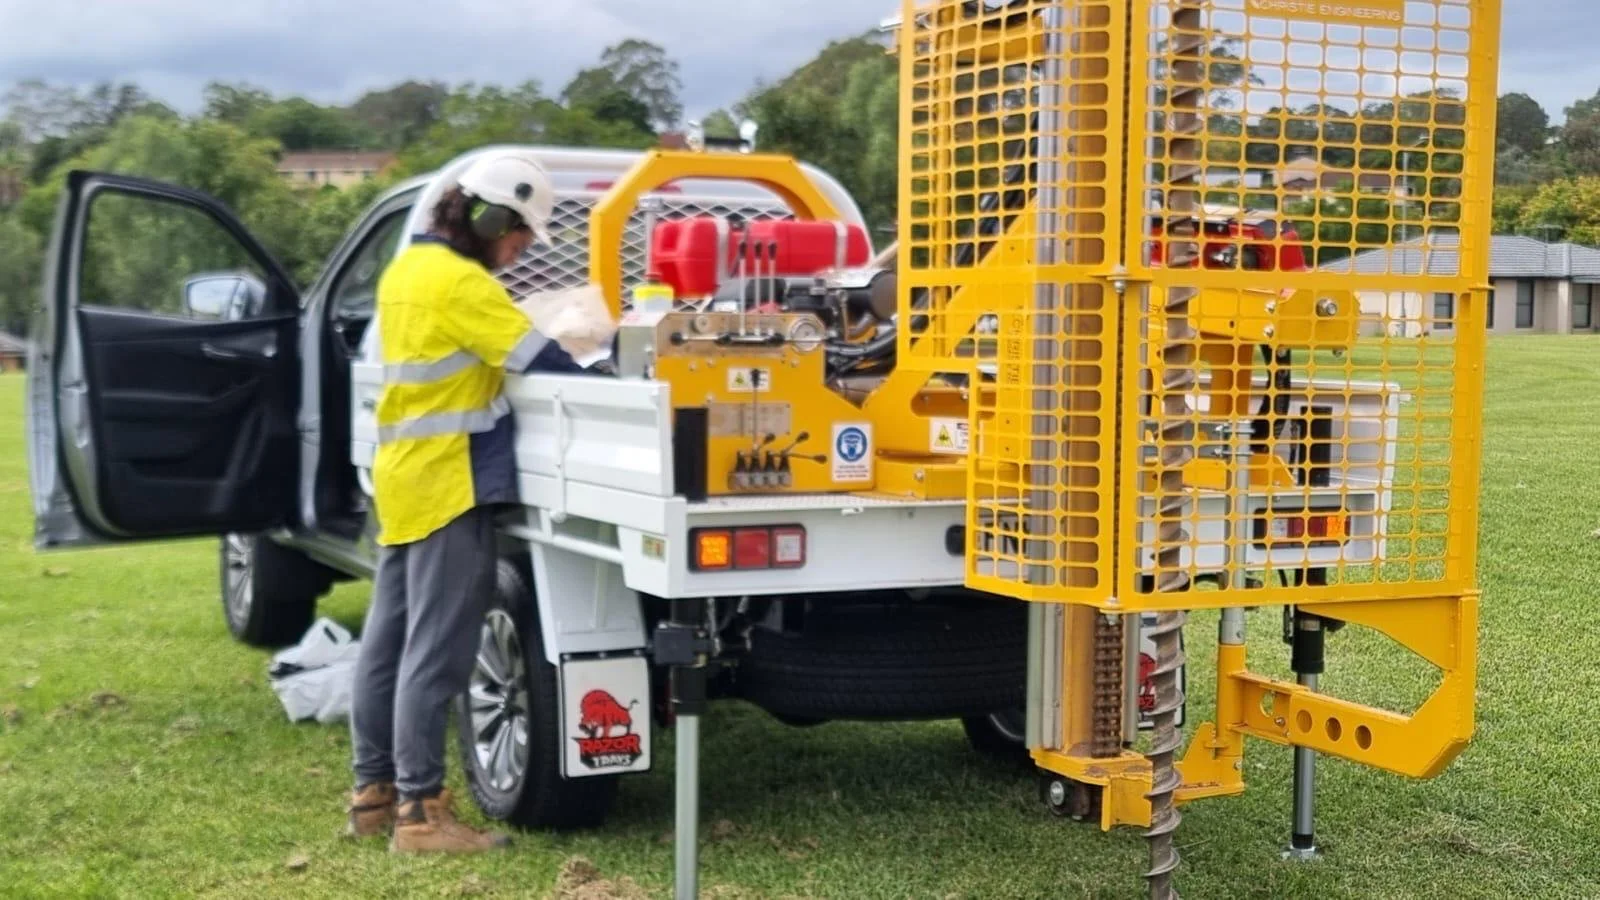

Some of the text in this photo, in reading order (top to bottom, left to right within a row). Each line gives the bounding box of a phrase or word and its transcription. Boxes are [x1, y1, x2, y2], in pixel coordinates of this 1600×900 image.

[1319, 4, 1401, 21] ENGINEERING
[580, 736, 640, 755] RAZOR
[591, 755, 631, 768] TRAYS
